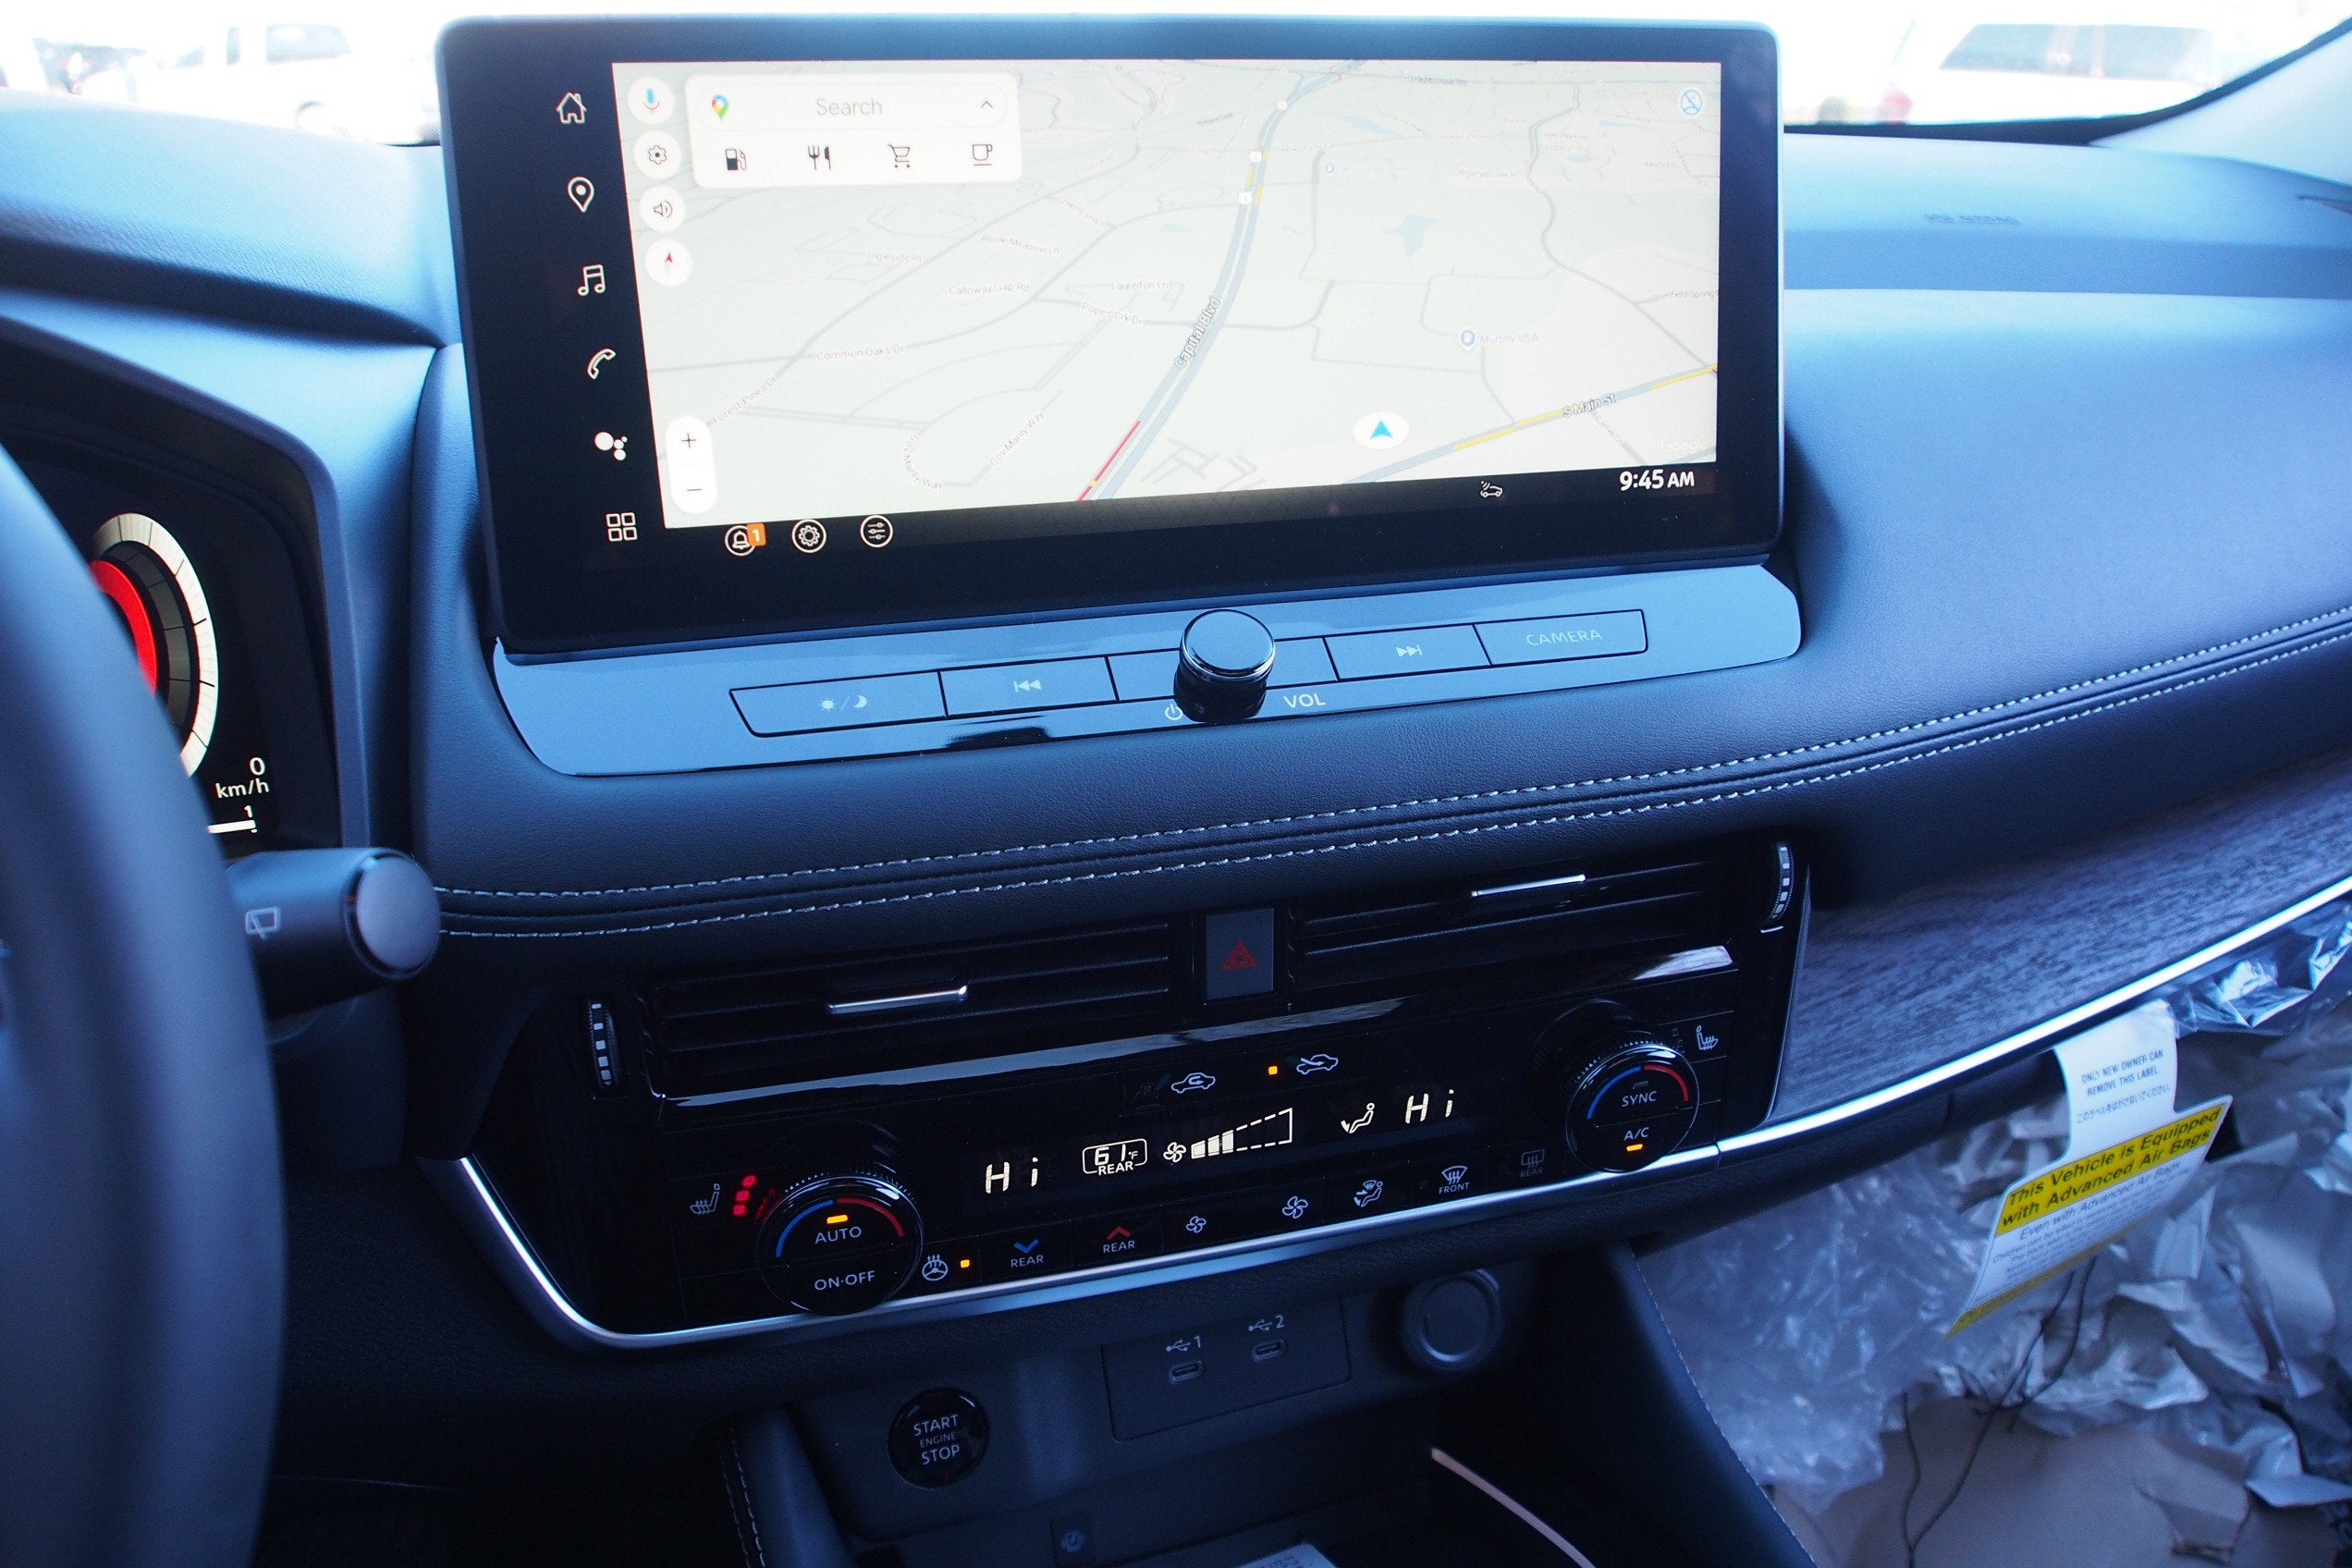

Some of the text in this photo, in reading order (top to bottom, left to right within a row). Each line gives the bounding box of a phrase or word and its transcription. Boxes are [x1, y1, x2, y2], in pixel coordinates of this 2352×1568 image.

[816, 97, 883, 116] Search
[949, 281, 1030, 297] Calloway Gap Rd
[1652, 290, 1688, 303] Brimfield
[1174, 296, 1220, 368] Capital Blvd
[1480, 333, 1539, 346] Murphy USA
[817, 345, 904, 361] Common Oaks Dr
[712, 401, 742, 425] Forest
[742, 386, 767, 406] Pines
[1562, 392, 1616, 418] S Main St
[989, 448, 1006, 466] Gov
[1026, 410, 1044, 431] Way
[1661, 436, 1709, 455] Google
[1620, 469, 1695, 491] 9:45 AM
[753, 527, 761, 544] 1
[1525, 629, 1603, 647] CAMERA
[1283, 691, 1327, 710] VOL
[249, 756, 265, 776] 0
[214, 778, 269, 799] km/h
[243, 804, 252, 818] 1
[2081, 1048, 2164, 1084] ONLY NEW OWNER CAN
[2087, 1080, 2117, 1097] REMOVE
[2119, 1073, 2136, 1086] THIS
[1404, 1088, 1455, 1124] Hi
[1622, 1090, 1658, 1108] SYNC
[1623, 1126, 1650, 1142] A/C
[1098, 1161, 1133, 1176] REAR
[2009, 1111, 2220, 1207] This Vehicle is Equipped
[985, 1157, 1039, 1194] Hi
[1520, 1166, 1545, 1179] REAR
[2003, 1203, 2040, 1228] with
[2046, 1159, 2135, 1210] Advanced
[2139, 1149, 2163, 1168] Air
[2170, 1128, 2211, 1157] Bags
[1439, 1182, 1470, 1195] FRONT
[2020, 1220, 2050, 1240] Even
[2053, 1207, 2076, 1225] with
[2080, 1182, 2134, 1211] Advanced
[815, 1226, 862, 1244] AUTO
[1102, 1239, 1135, 1254] REAR
[1011, 1254, 1045, 1268] REAR
[1274, 1316, 1285, 1330] 2
[1193, 1335, 1202, 1350] 1
[913, 1413, 960, 1438] START
[919, 1432, 957, 1450] ENGINE
[921, 1443, 962, 1467] STOP
